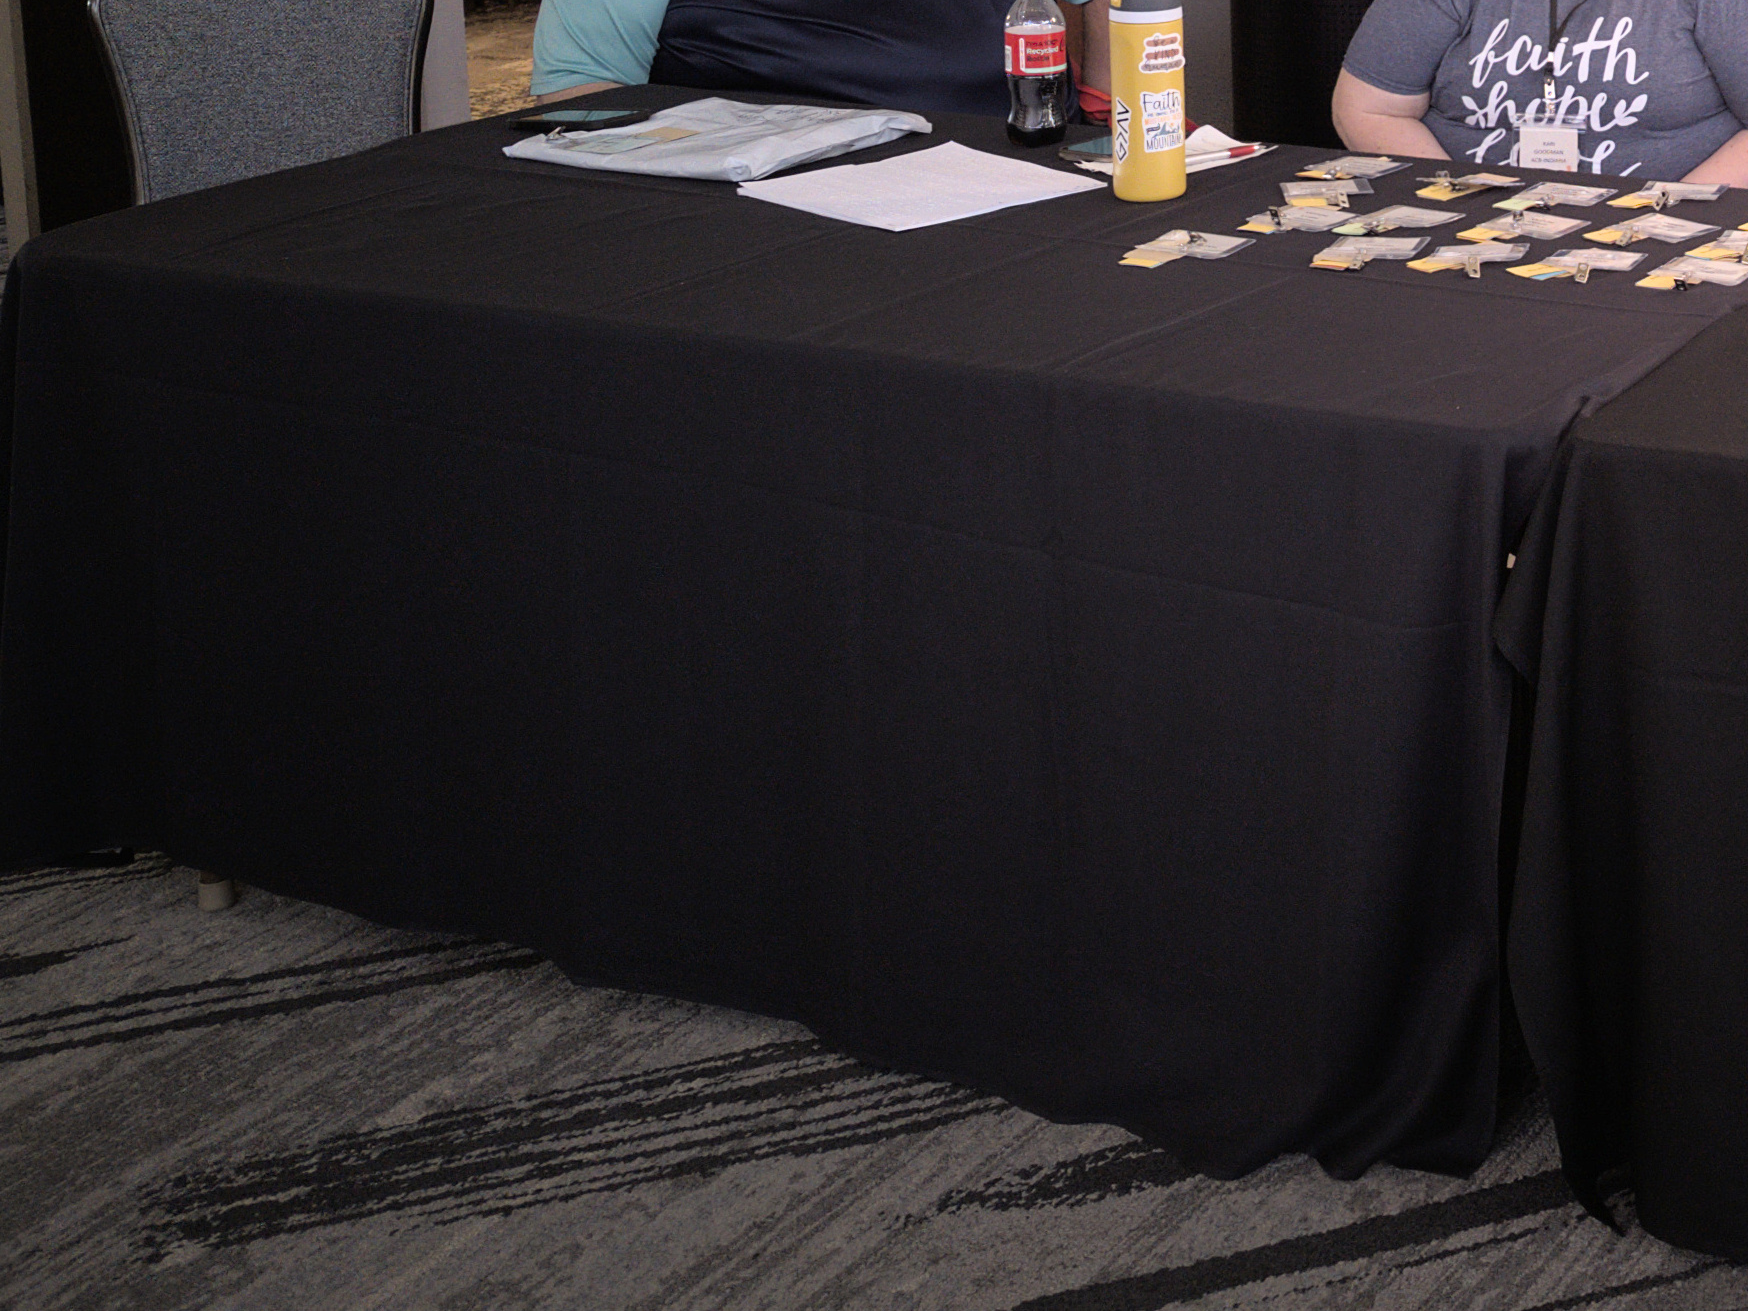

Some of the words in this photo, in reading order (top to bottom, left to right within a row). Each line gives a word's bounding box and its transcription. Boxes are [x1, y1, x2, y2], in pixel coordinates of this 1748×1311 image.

[1026, 46, 1059, 55] Recycled
[1469, 17, 1650, 89] faith
[1142, 91, 1180, 113] Faith
[1481, 81, 1620, 132] hope
